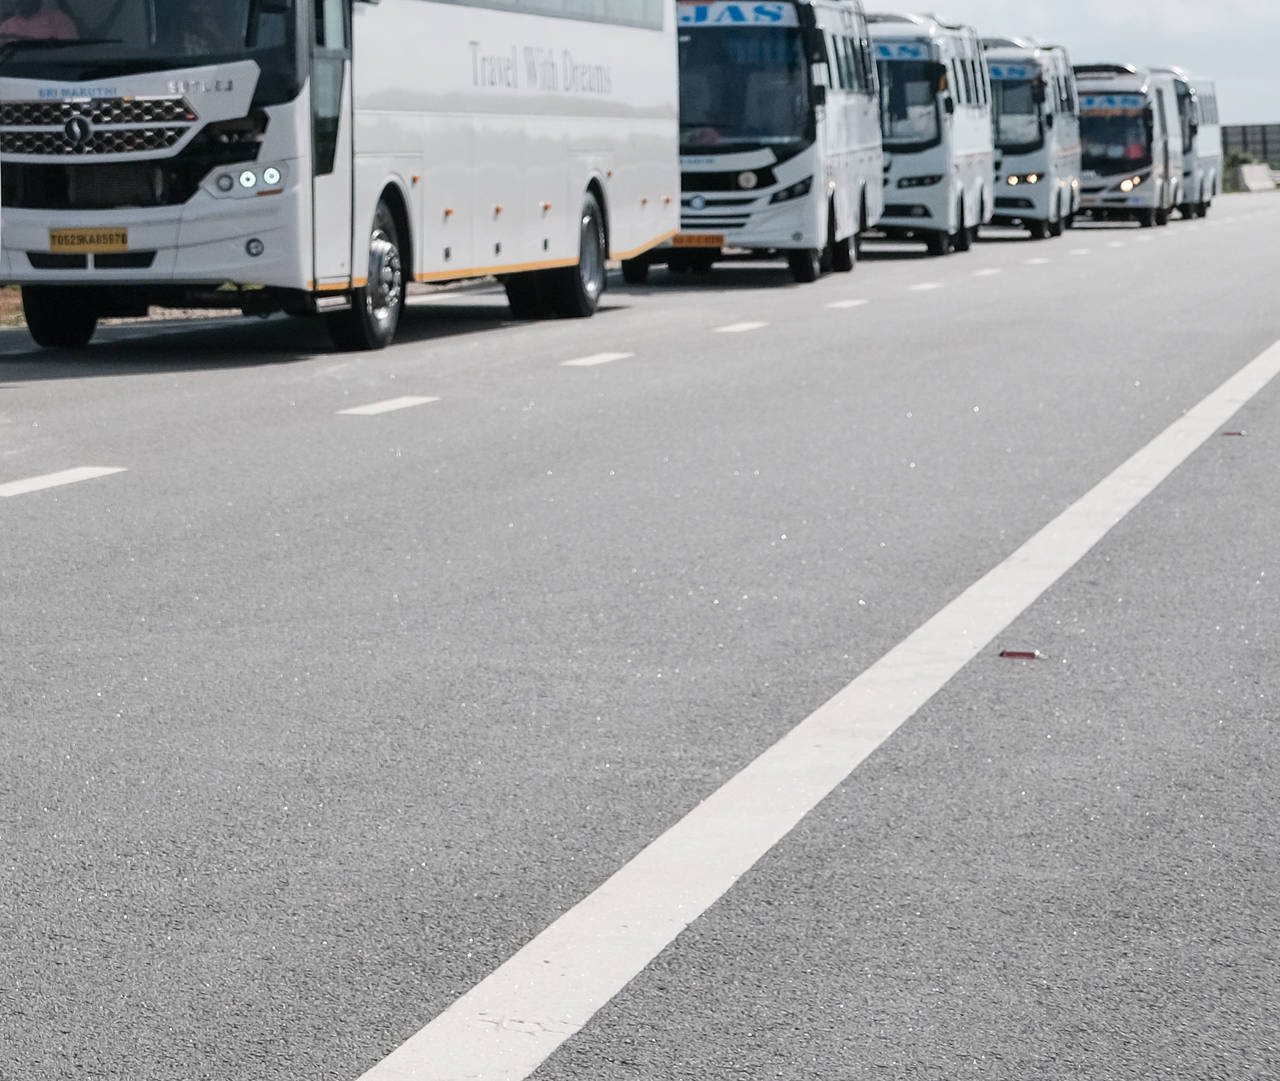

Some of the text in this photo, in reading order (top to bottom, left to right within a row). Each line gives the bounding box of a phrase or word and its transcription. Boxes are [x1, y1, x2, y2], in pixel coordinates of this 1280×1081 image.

[681, 5, 783, 22] JAS
[468, 40, 613, 95] Travel With Dreams
